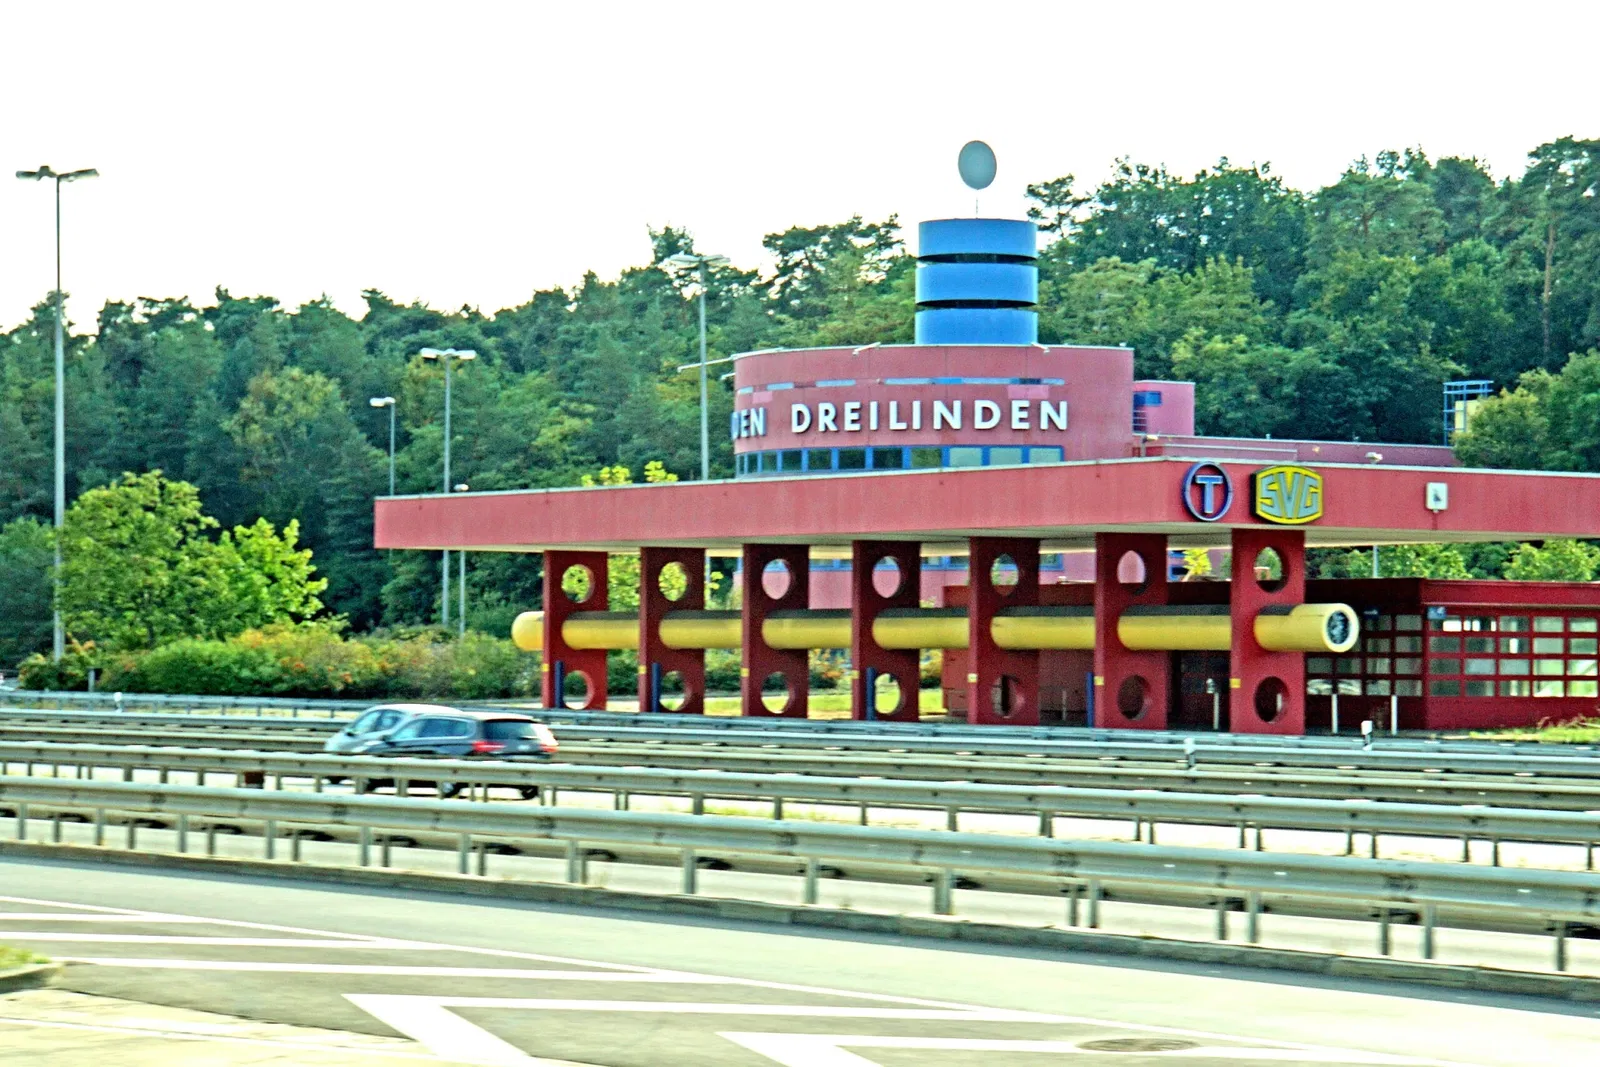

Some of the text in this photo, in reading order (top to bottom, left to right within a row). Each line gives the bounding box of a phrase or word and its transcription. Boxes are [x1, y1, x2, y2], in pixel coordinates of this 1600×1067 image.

[791, 400, 1069, 433] DREILINDEN
[1196, 475, 1223, 514] T
[1260, 472, 1319, 518] SVG
